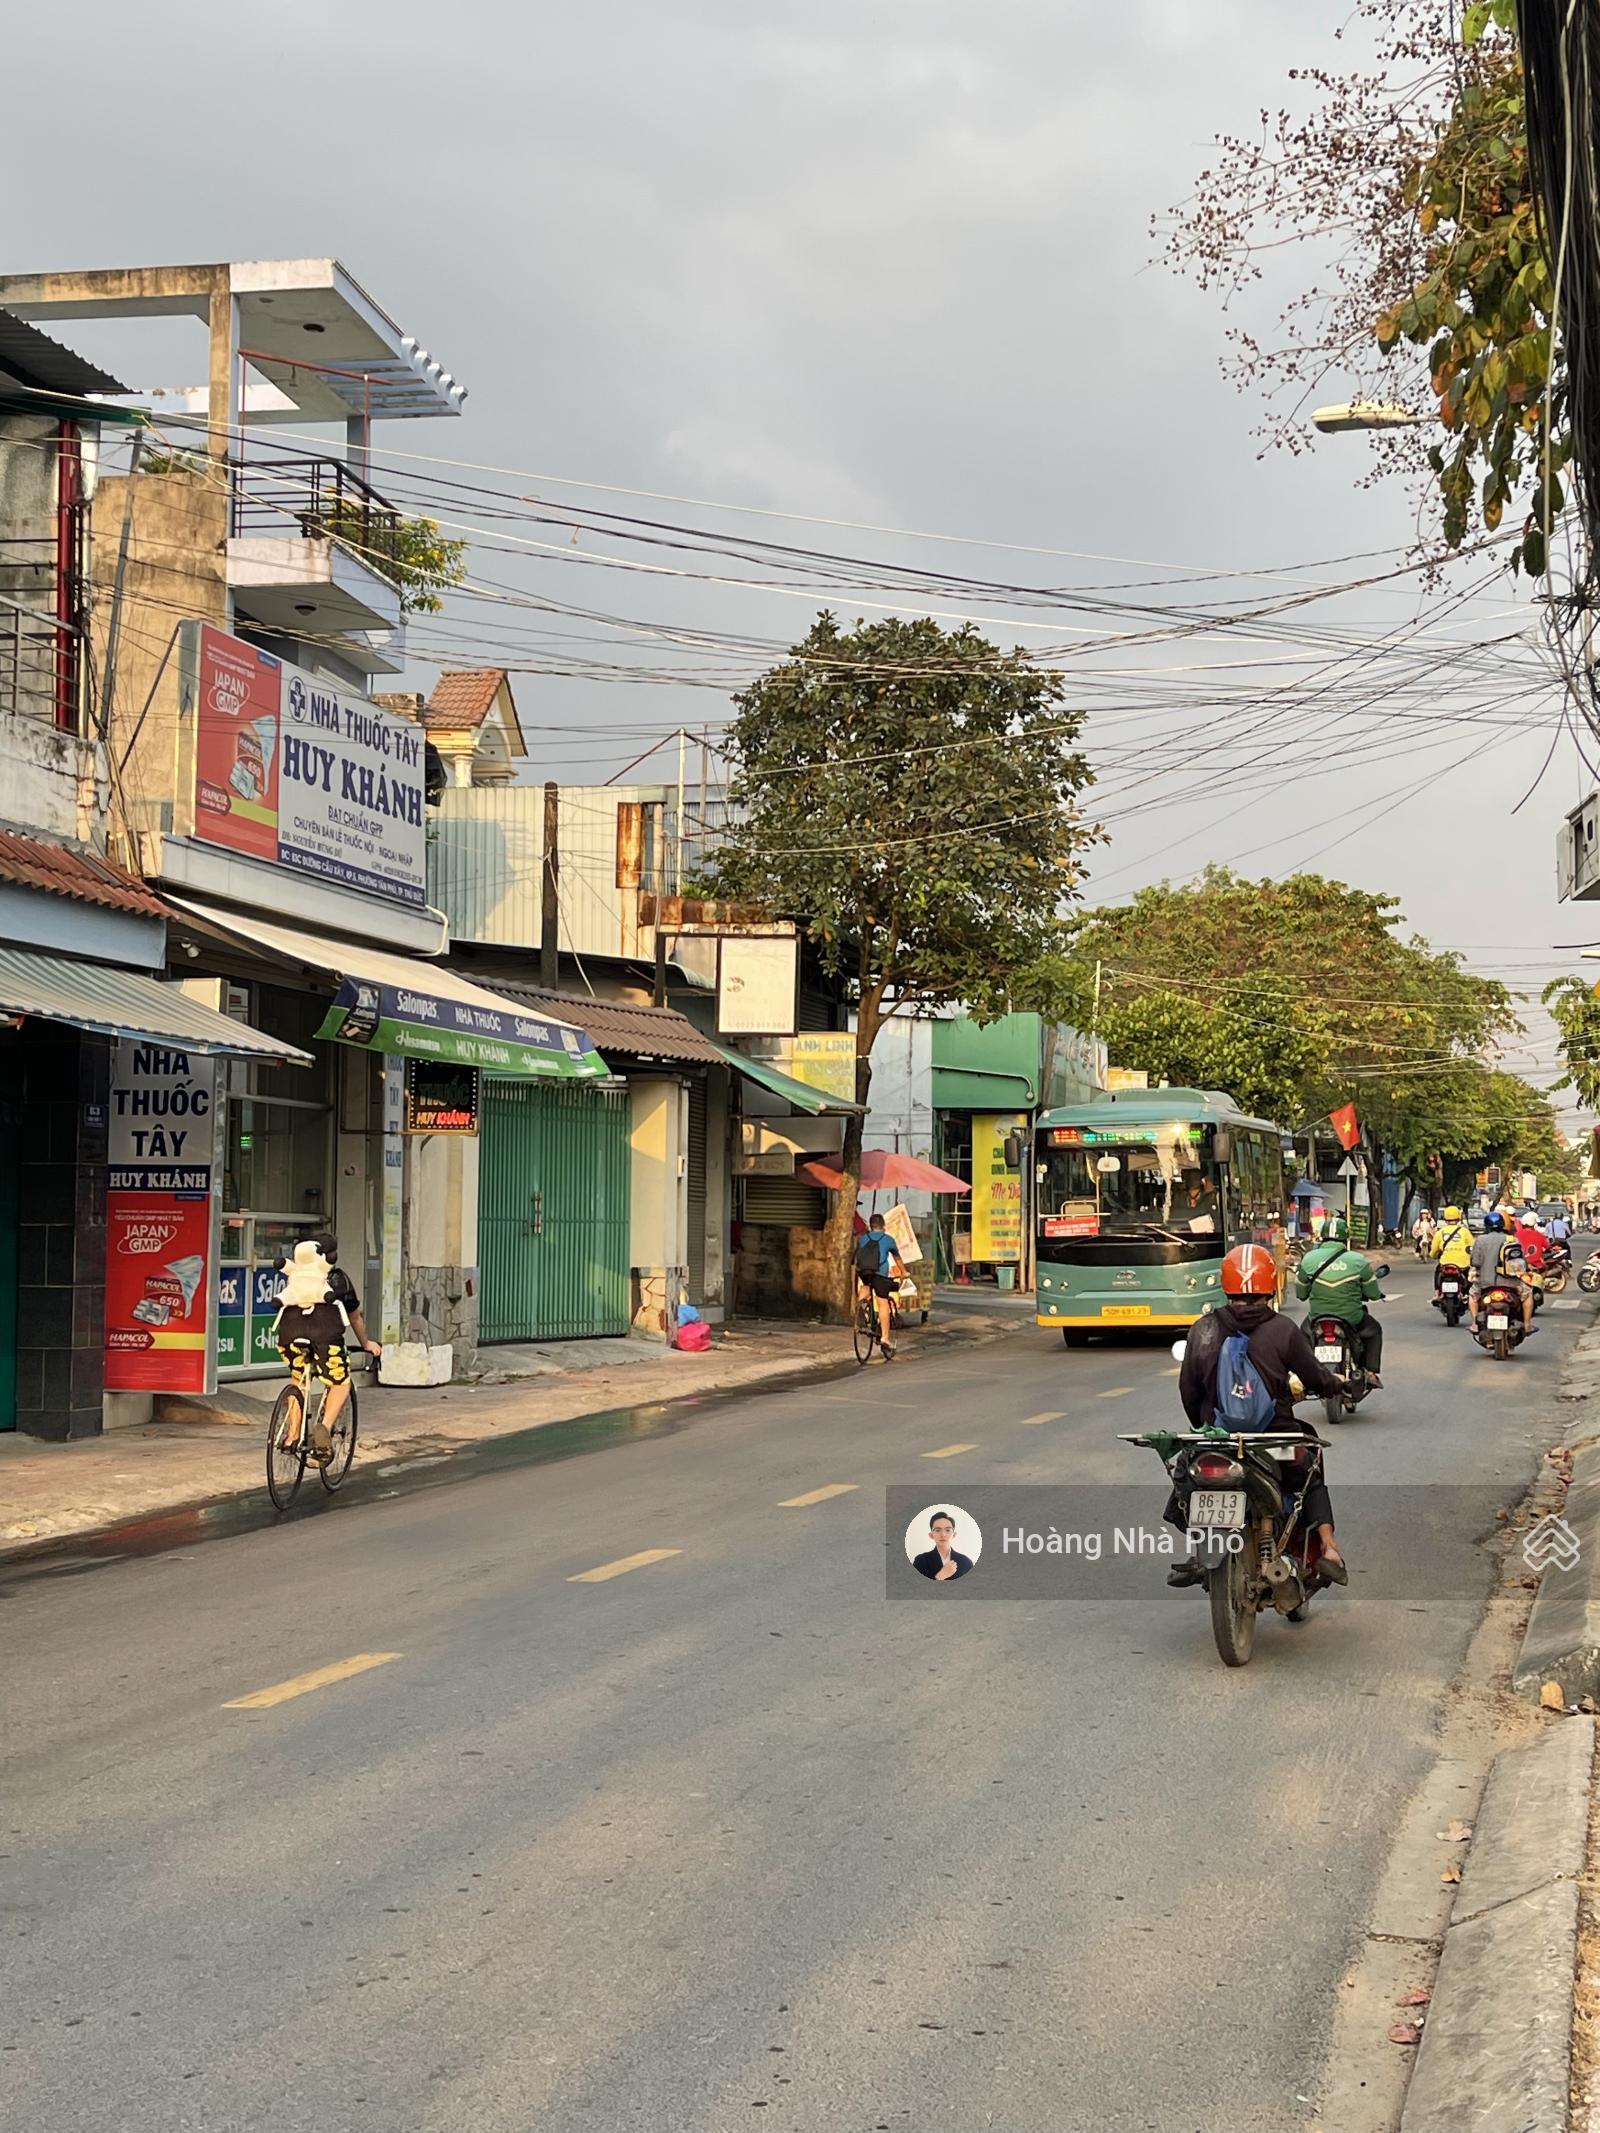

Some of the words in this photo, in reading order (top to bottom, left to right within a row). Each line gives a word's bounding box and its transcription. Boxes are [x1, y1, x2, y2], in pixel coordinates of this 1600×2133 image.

[214, 669, 245, 698] JAPAN
[217, 692, 238, 711] GMP
[310, 692, 340, 733] NHÀ
[344, 713, 390, 755] THUỐC
[394, 728, 419, 767] TÂY
[283, 734, 336, 792] HUY
[341, 762, 422, 827] KHÁNH
[294, 816, 320, 836] CHUYÊN
[369, 821, 384, 837] GPP
[396, 990, 438, 1020] Salonpas
[455, 1007, 474, 1026] NHÀ
[473, 1011, 501, 1031] THUỐC
[514, 1016, 550, 1043] Salonpas
[456, 1039, 477, 1058] HUY
[478, 1041, 511, 1064] KHÁNH
[112, 1079, 209, 1116] THUỐC
[416, 1111, 436, 1125] HUY
[436, 1109, 471, 1125] KHÁNH
[131, 1124, 188, 1157] TÂY
[109, 1172, 144, 1188] HUY
[147, 1168, 207, 1188] KHÁNH
[124, 1224, 169, 1240] JAPAN
[131, 1239, 161, 1251] GMP
[145, 1279, 181, 1292] HAPACOL
[159, 1295, 180, 1307] 650
[109, 1333, 149, 1343] HAPACOL
[1198, 1494, 1238, 1509] 86-L3
[1197, 1510, 1236, 1525] 0797
